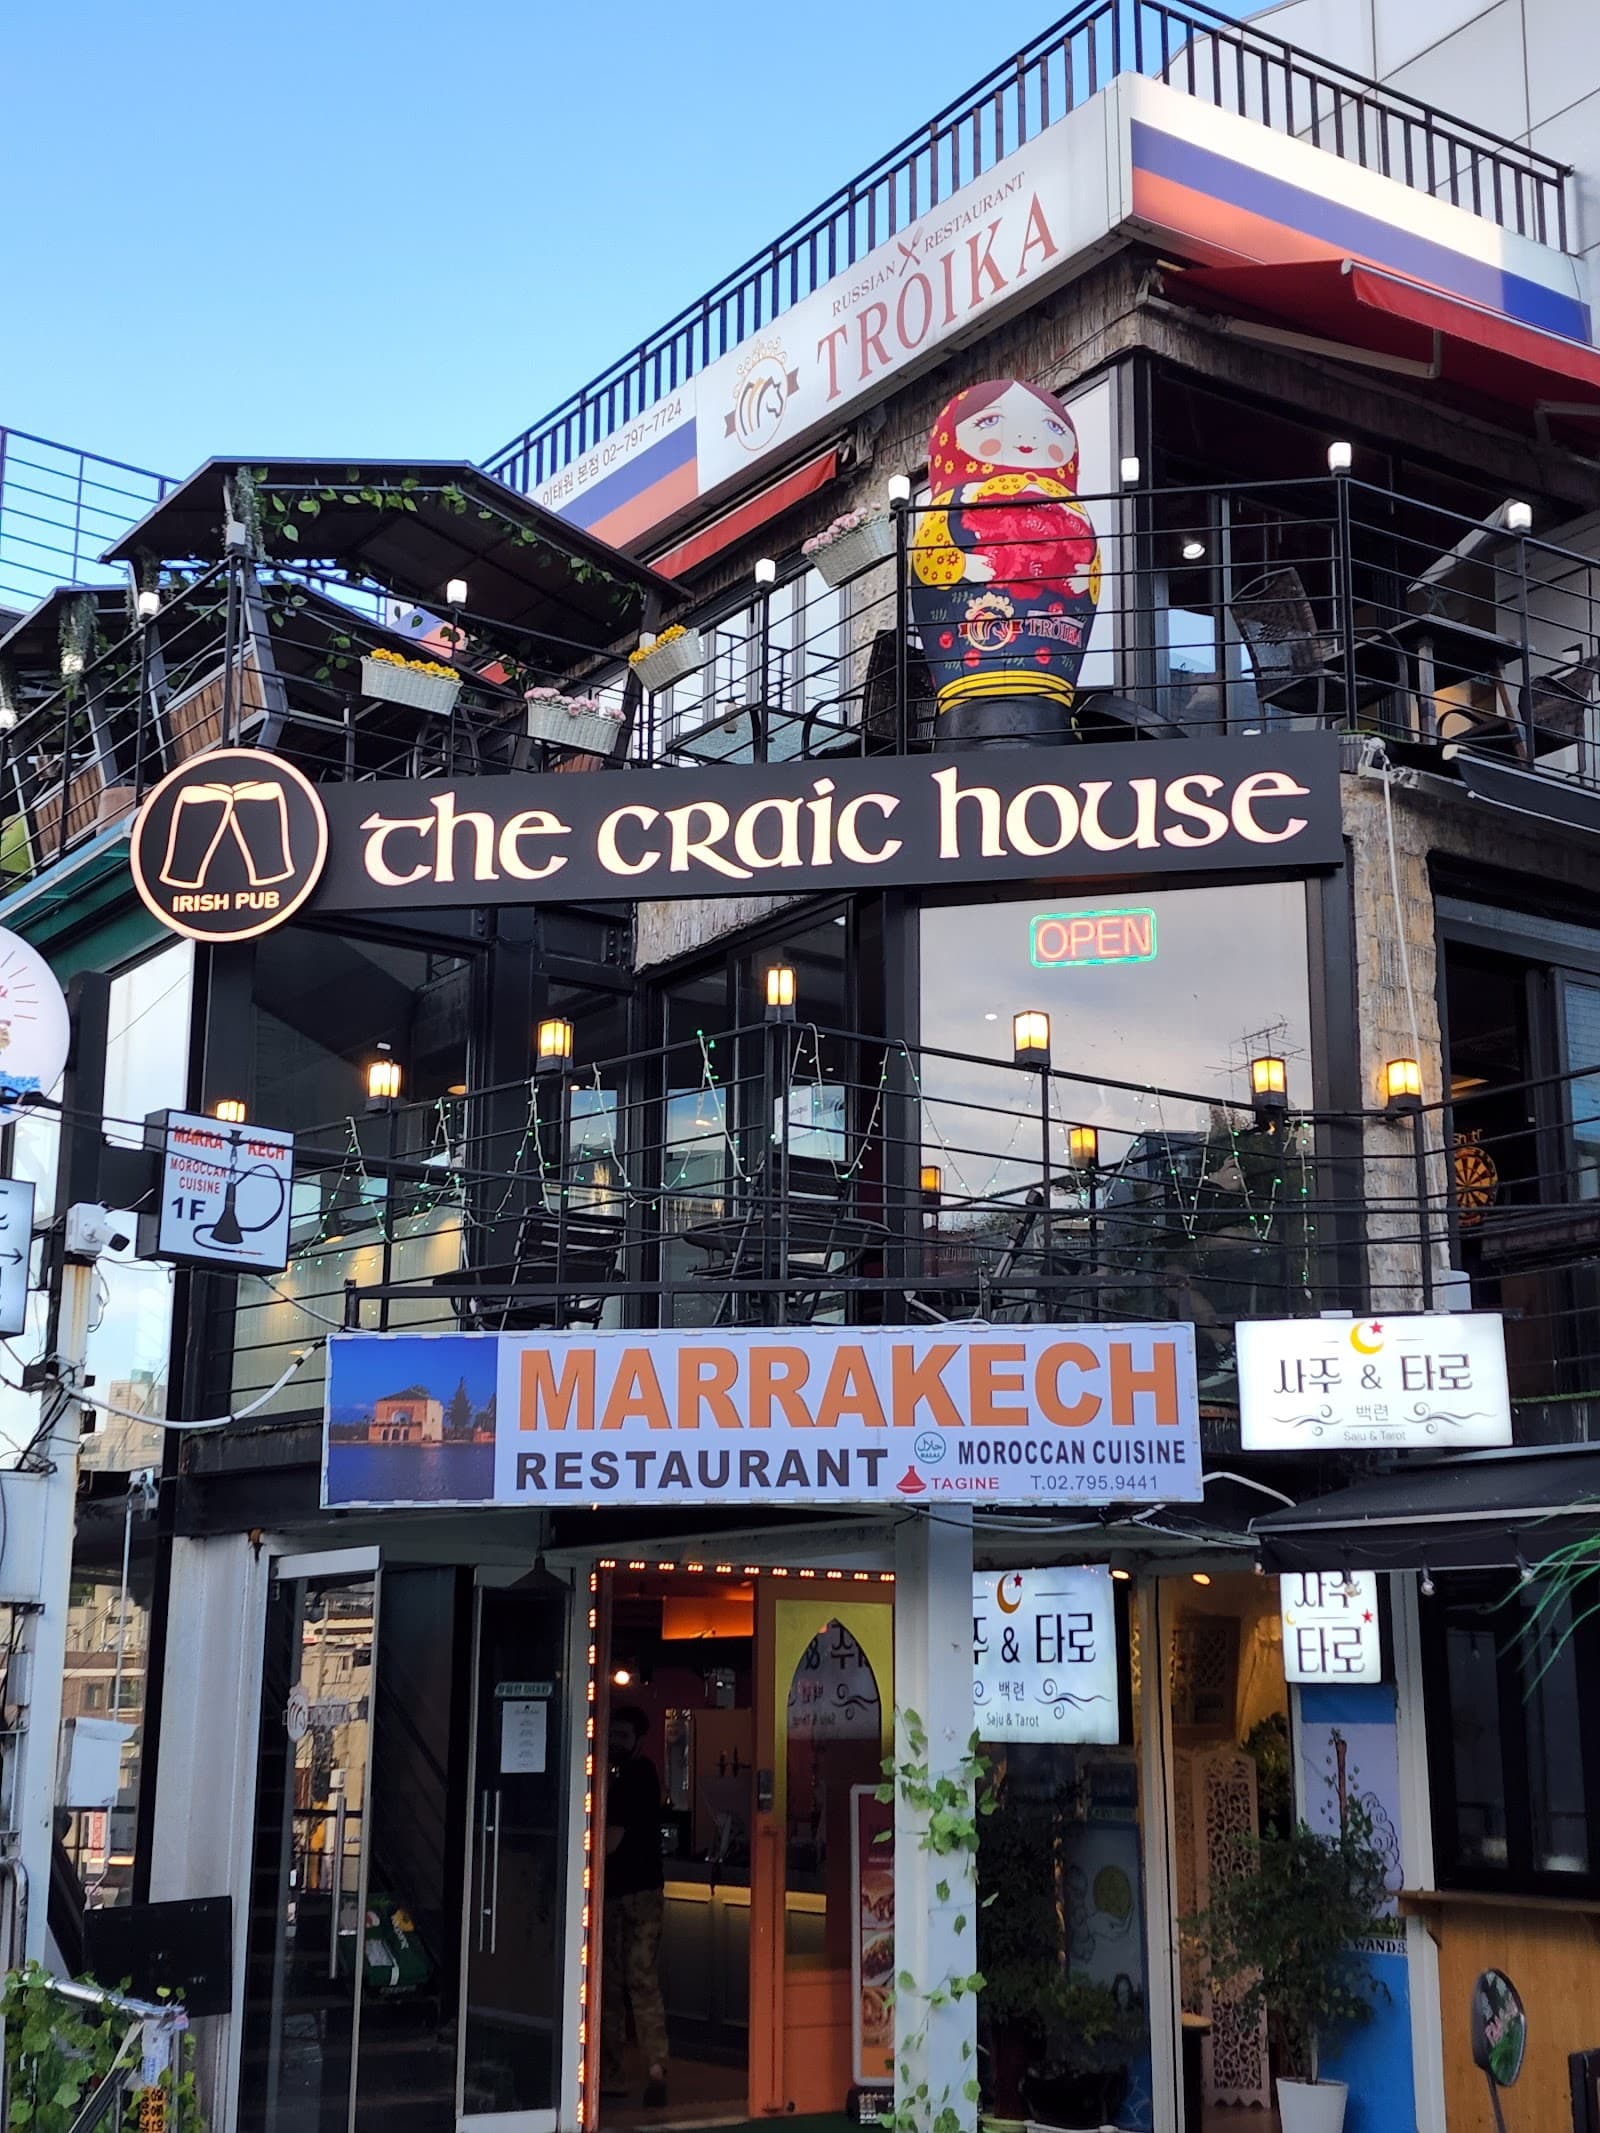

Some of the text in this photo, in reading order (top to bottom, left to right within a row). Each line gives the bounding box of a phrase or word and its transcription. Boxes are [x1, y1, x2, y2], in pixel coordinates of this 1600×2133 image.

[832, 171, 1026, 317] RUSSIAN RESTAURANT
[816, 191, 1060, 402] TROIKA
[543, 398, 682, 506] 이태원 본점 02-797-7724
[172, 891, 280, 913] IRISH PUB
[1036, 916, 1151, 960] OPEN
[170, 1158, 227, 1178] MOROCCAN
[179, 1177, 220, 1194] CUISINE
[171, 1197, 206, 1221] 1F
[1273, 1353, 1473, 1394] 사주 & 타로
[519, 1342, 1179, 1431] MARRAKECH
[1355, 1403, 1389, 1422] 백련
[1343, 1430, 1367, 1442] Saju
[1369, 1430, 1378, 1441] &
[958, 1440, 1186, 1465] MOROCCAN CUISINE
[516, 1448, 888, 1490] RESTAURANT
[931, 1477, 999, 1490] TAGINE
[1030, 1475, 1159, 1491] T.02.795.9441
[1001, 1626, 1021, 1663] &
[1036, 1613, 1096, 1664] 타로
[1296, 1626, 1366, 1673] 타로
[986, 1713, 1039, 1728] Saju & Tarot
